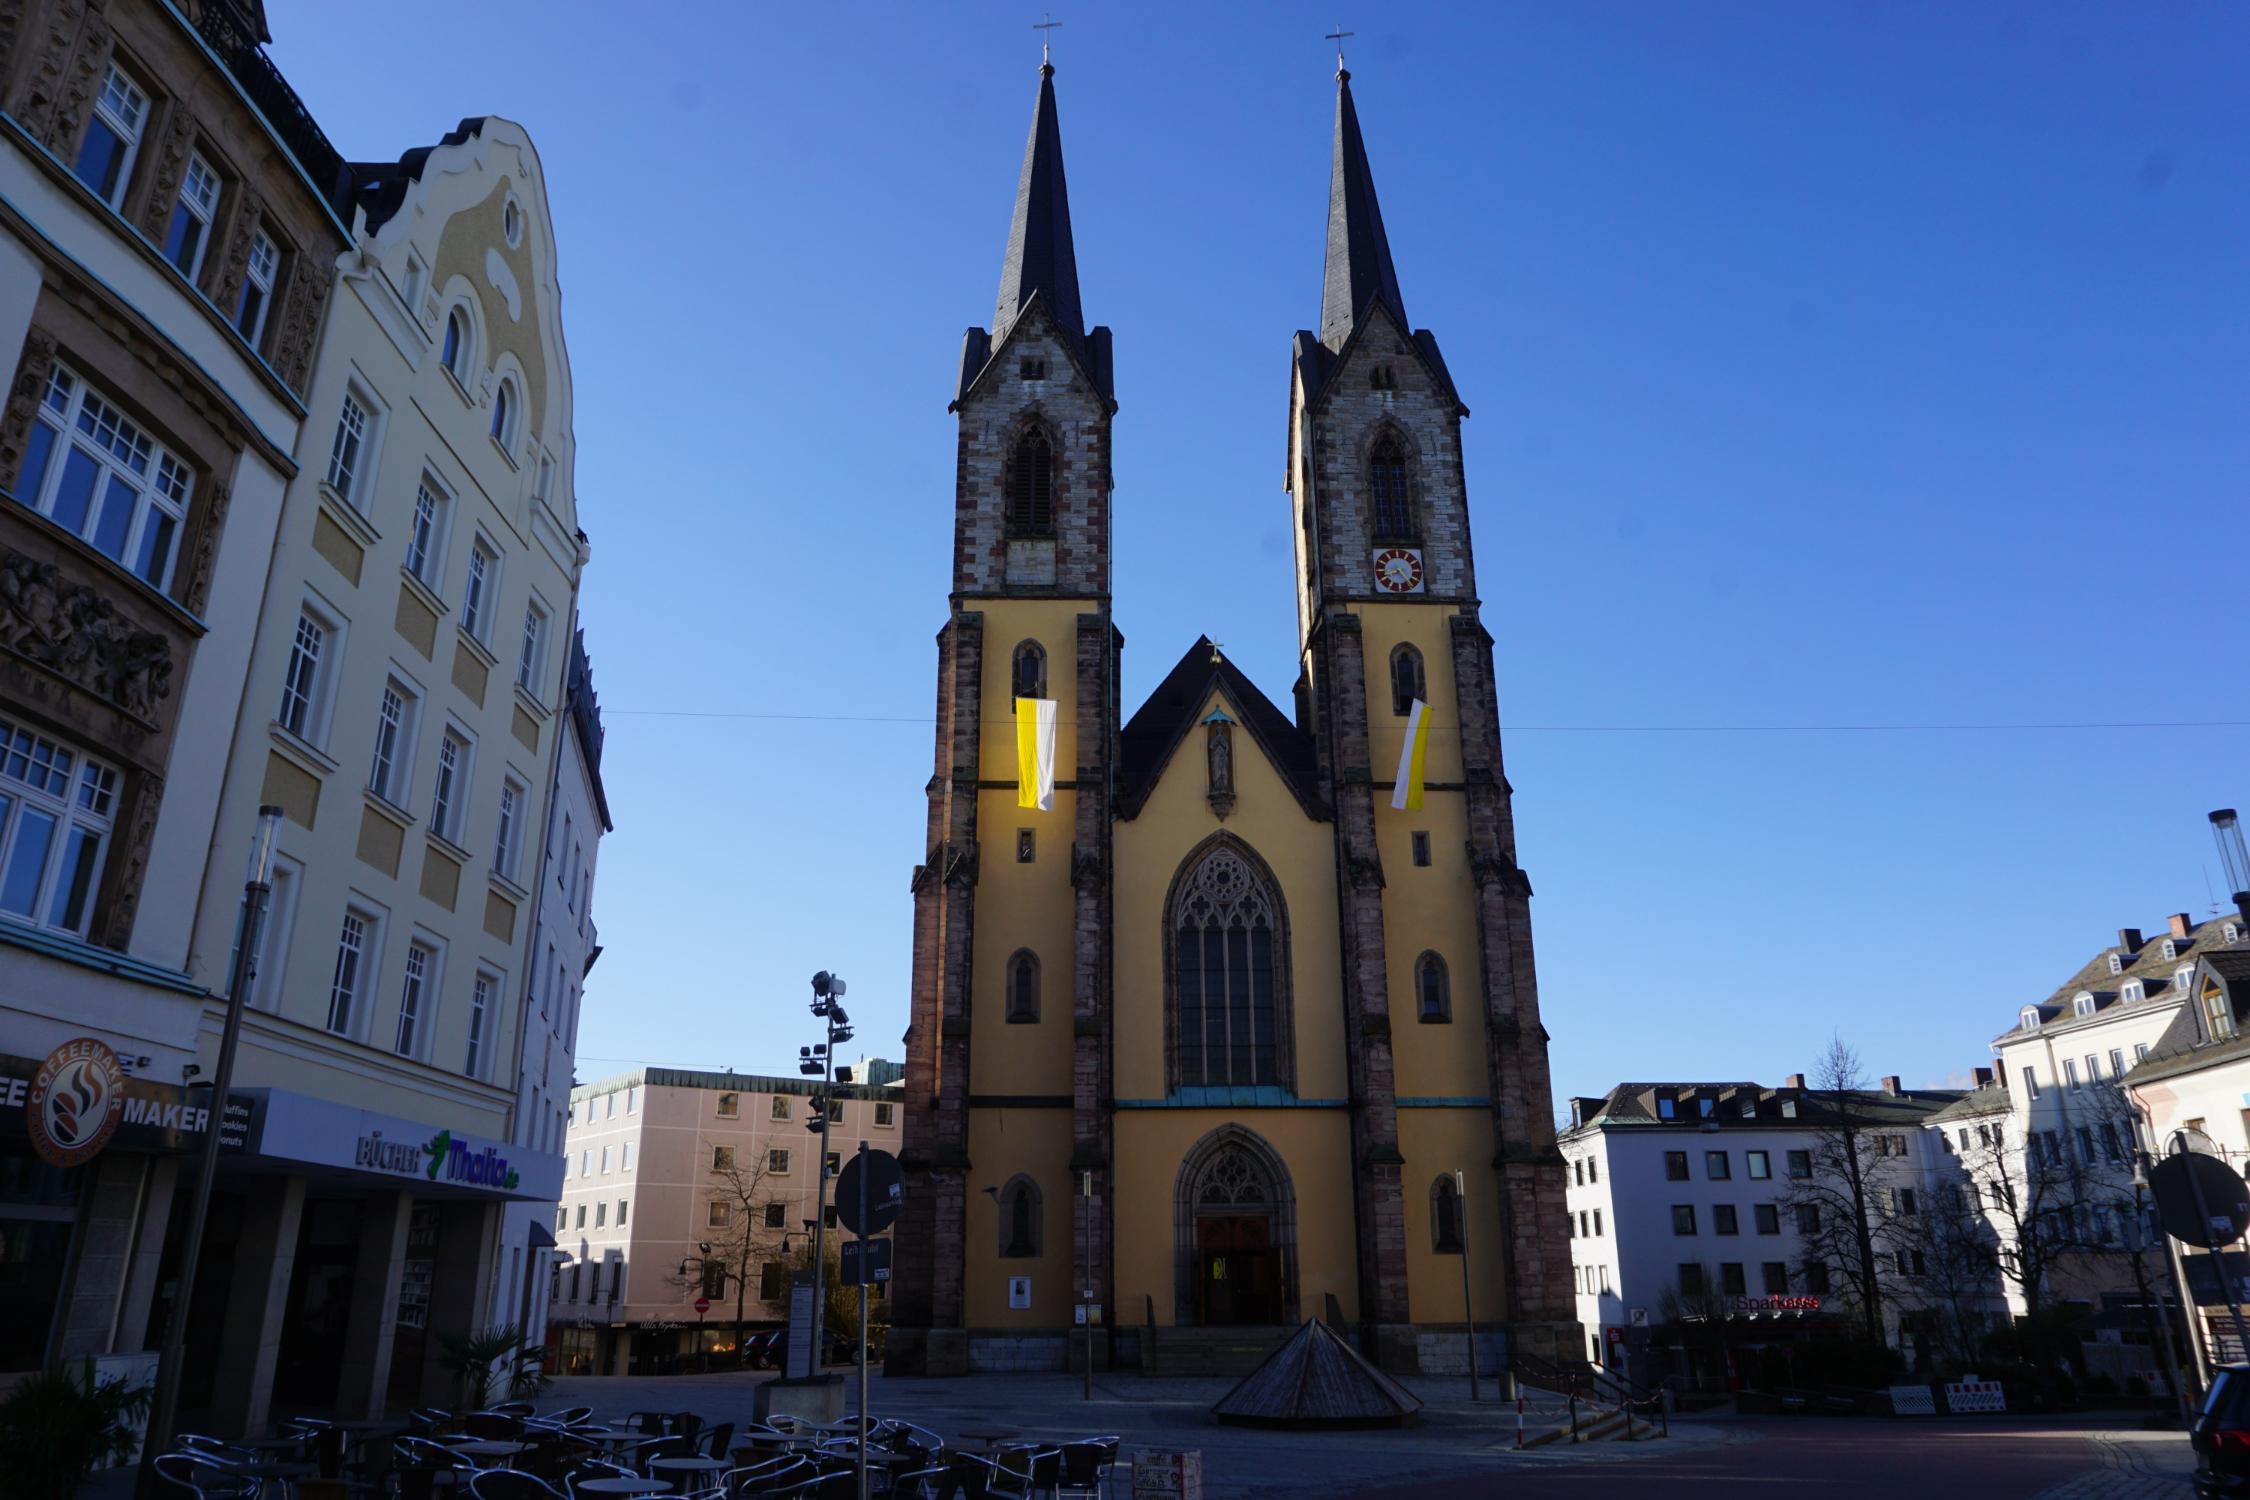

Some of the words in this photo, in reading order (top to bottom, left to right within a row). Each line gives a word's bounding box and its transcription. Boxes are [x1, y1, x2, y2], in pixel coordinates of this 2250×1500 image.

[31, 1041, 124, 1112] COFFEEMAKER
[124, 1097, 208, 1132] MAKER
[224, 1103, 249, 1117] uffins
[221, 1119, 247, 1132] ookies
[220, 1135, 243, 1146] onuts
[357, 1131, 420, 1173] BÜCHER
[1737, 1293, 1820, 1311] Sparkasse
